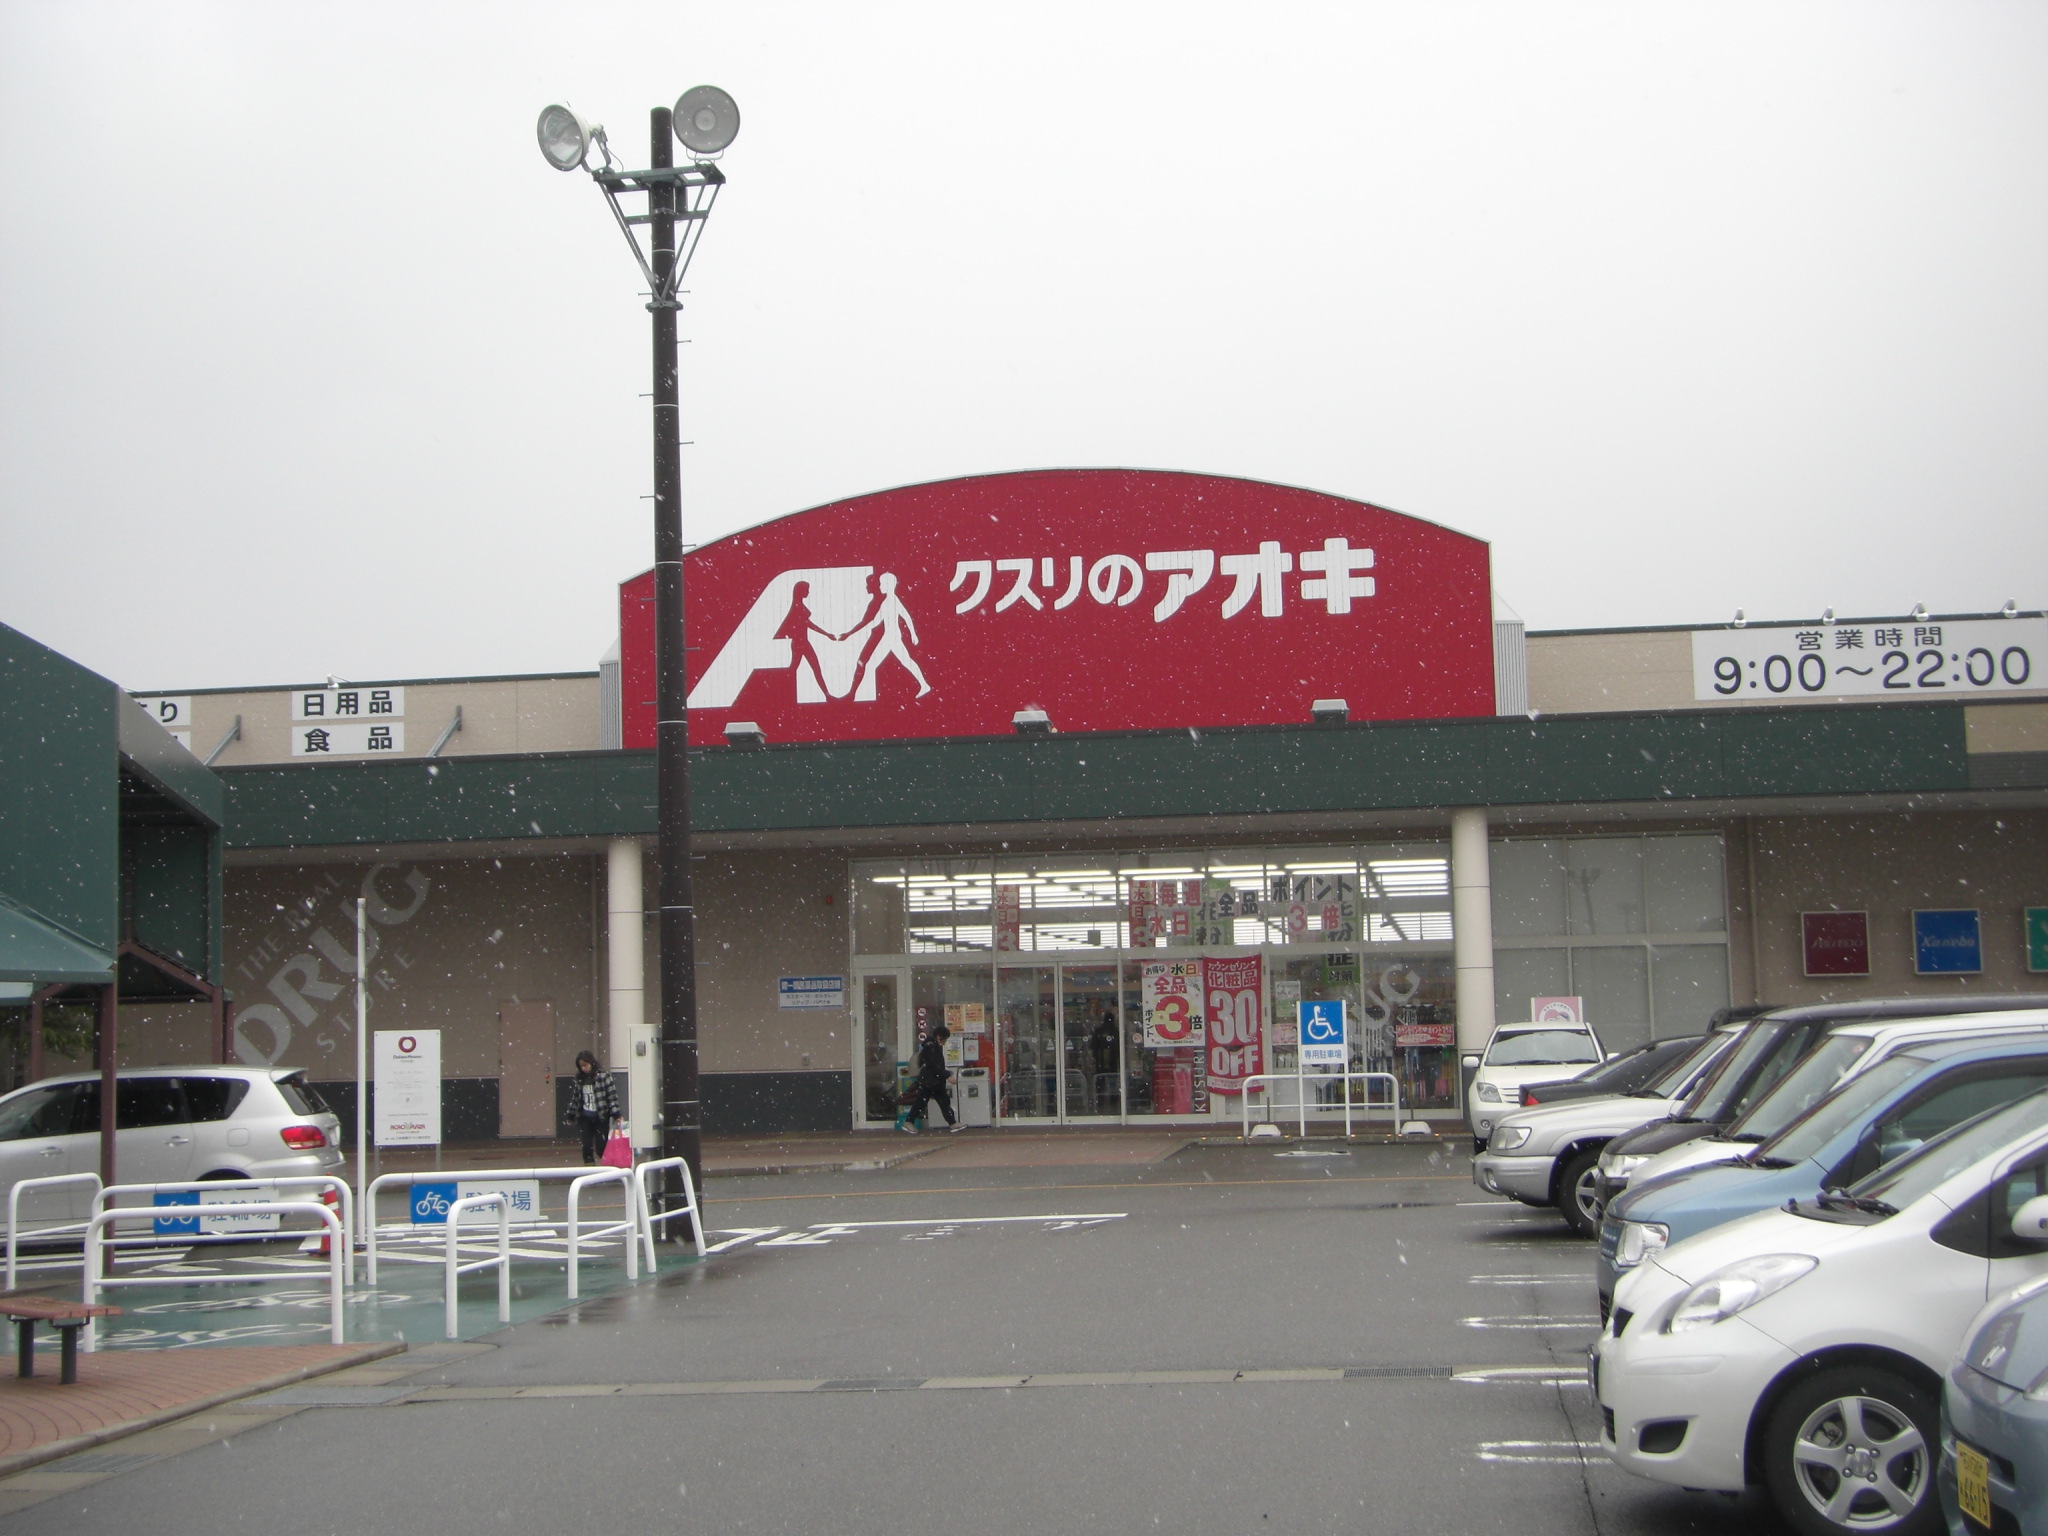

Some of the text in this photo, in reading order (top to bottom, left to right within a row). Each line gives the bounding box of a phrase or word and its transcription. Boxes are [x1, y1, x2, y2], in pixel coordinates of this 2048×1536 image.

[949, 537, 1376, 622] クスリのアオキ
[1795, 626, 1944, 651] 営業時間
[303, 690, 393, 717] 日用品
[304, 726, 393, 753] 食品
[1272, 875, 1353, 902] ポイント
[1921, 935, 1975, 948] Kanebo
[234, 862, 430, 1066] DRUG
[1154, 976, 1188, 995] 全品
[1211, 1044, 1260, 1077] OFF
[1193, 1049, 1207, 1113] KUSURI
